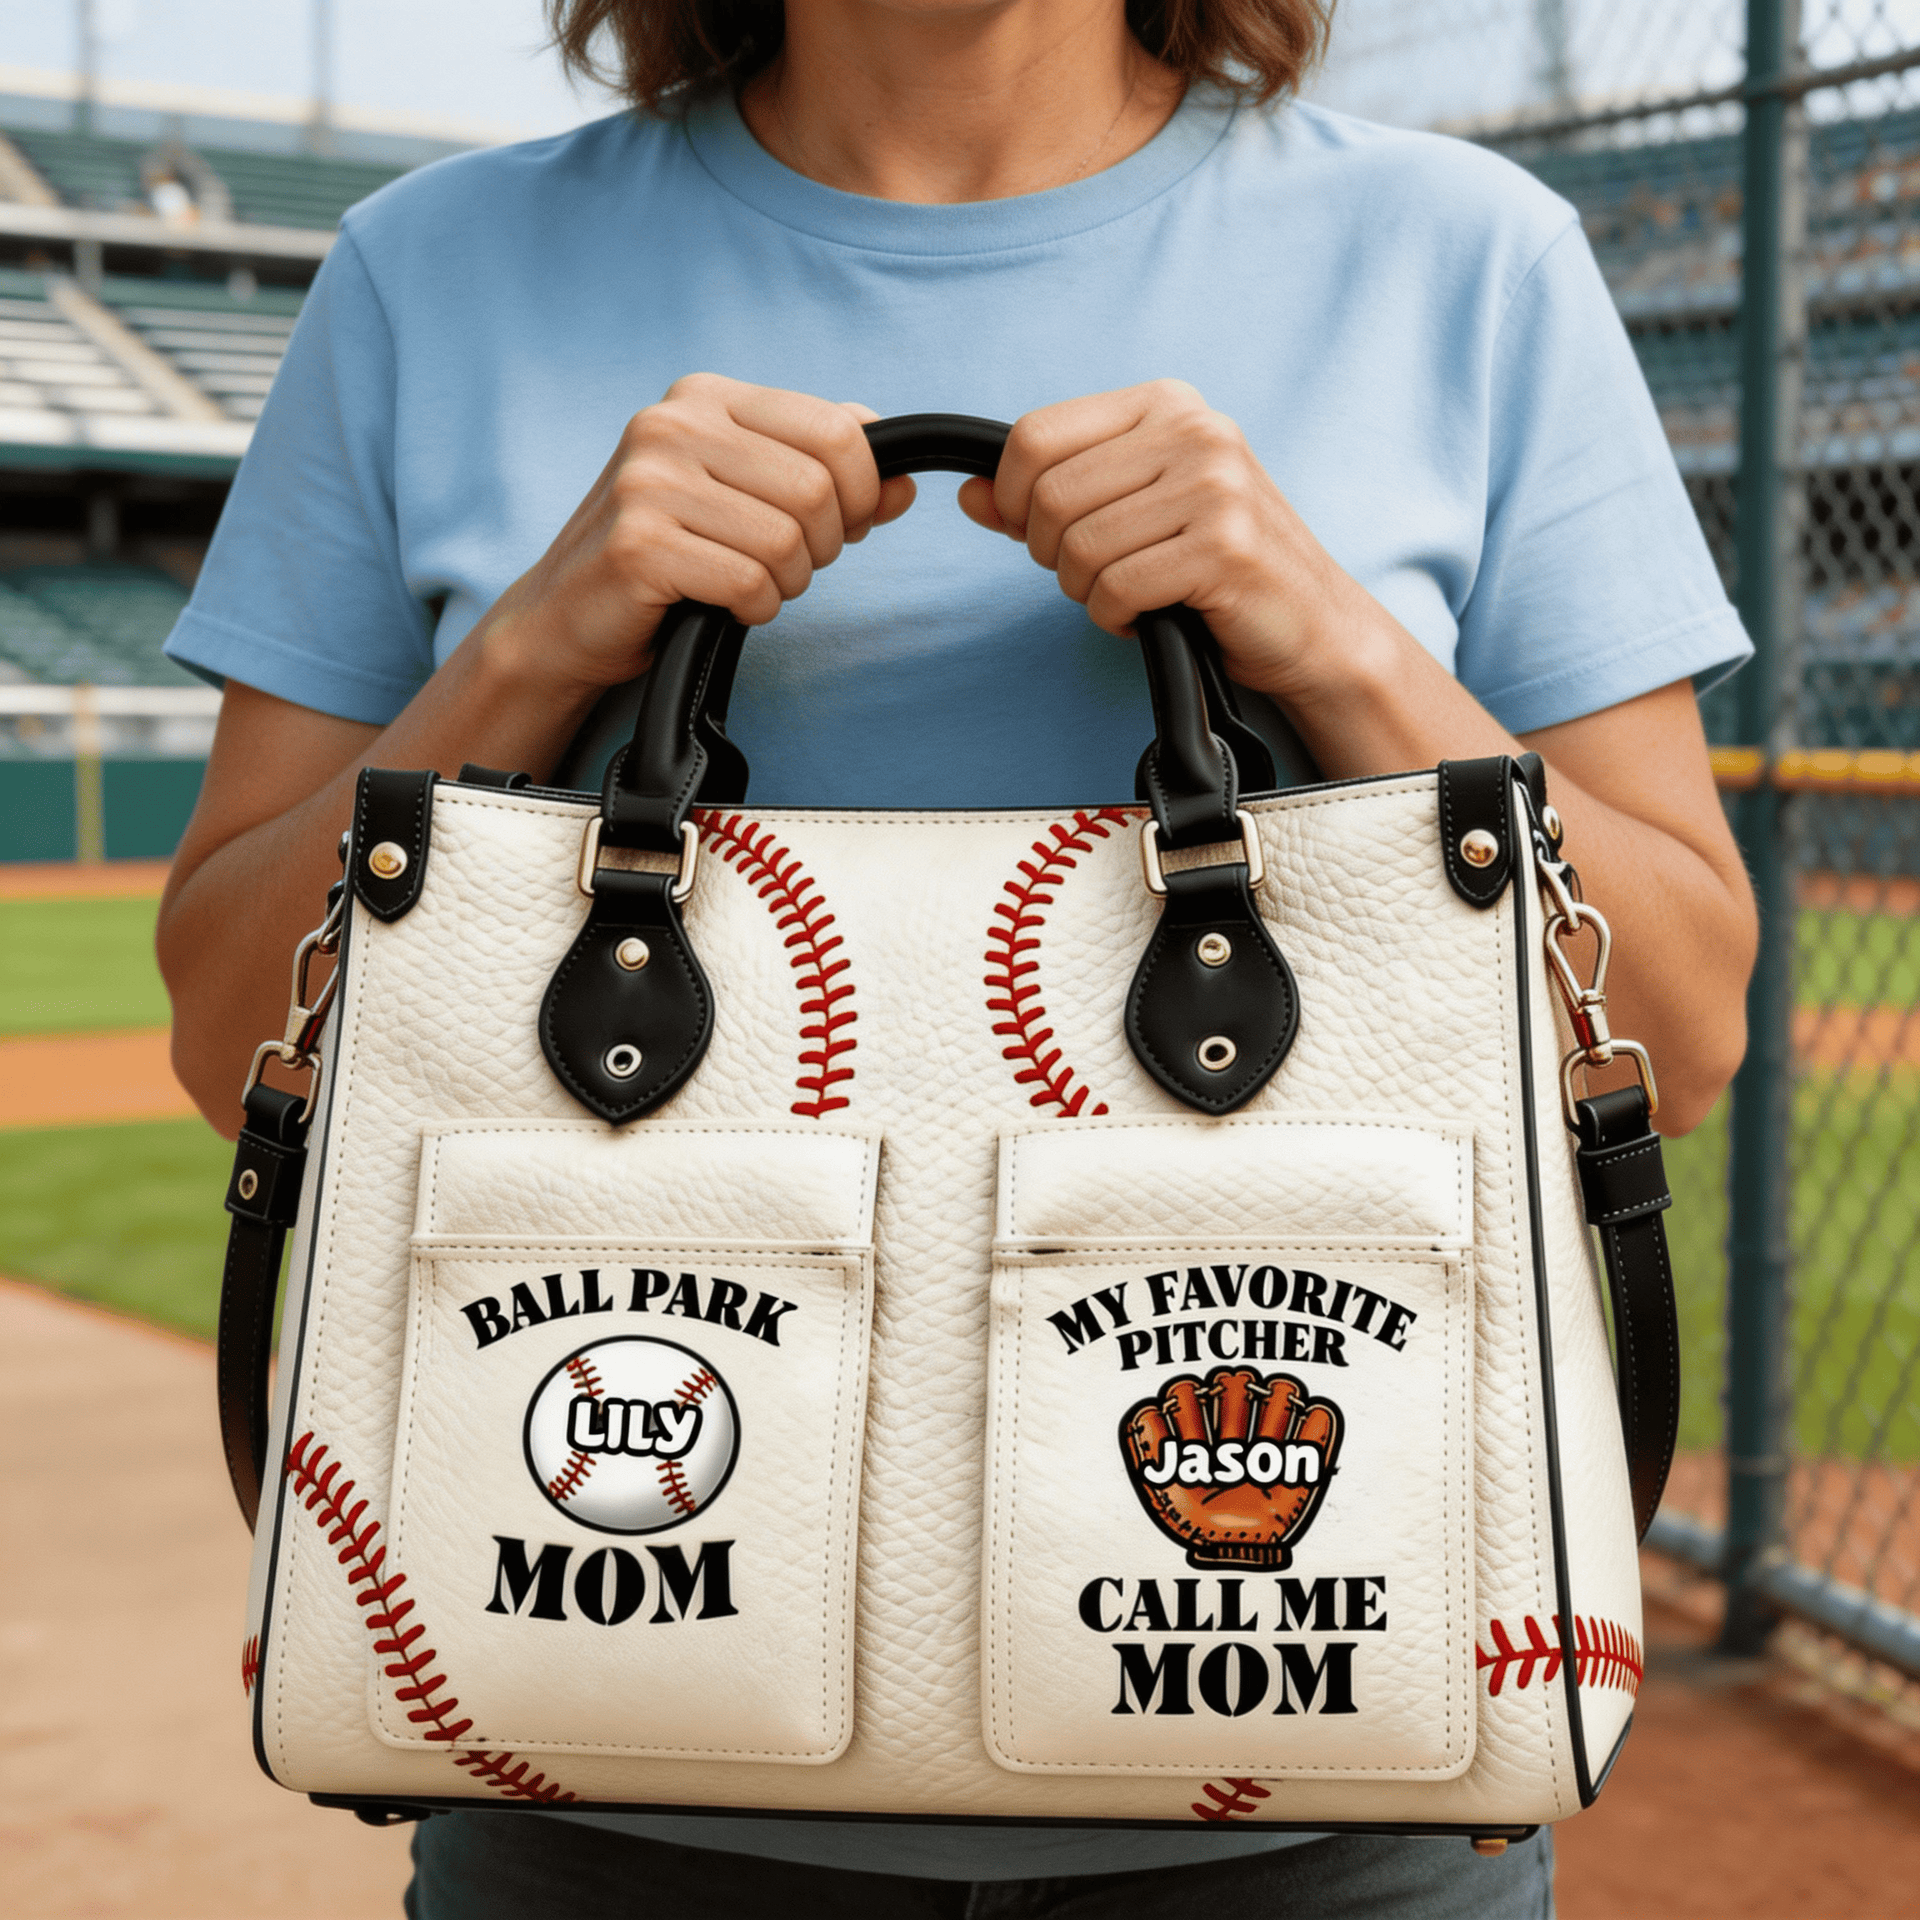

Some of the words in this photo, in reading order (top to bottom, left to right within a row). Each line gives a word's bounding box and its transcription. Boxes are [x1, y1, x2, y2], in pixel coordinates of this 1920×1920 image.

[459, 1269, 614, 1350] BALL
[627, 1268, 799, 1347] PARK
[1046, 1282, 1129, 1355] MY
[1145, 1264, 1418, 1353] FAVORITE
[1116, 1319, 1350, 1371] PITCHER
[1141, 1438, 1322, 1486] Jason
[484, 1535, 739, 1626] MOM
[1078, 1577, 1259, 1633] CALL
[1273, 1576, 1388, 1632] ME
[1110, 1642, 1359, 1718] MOM
